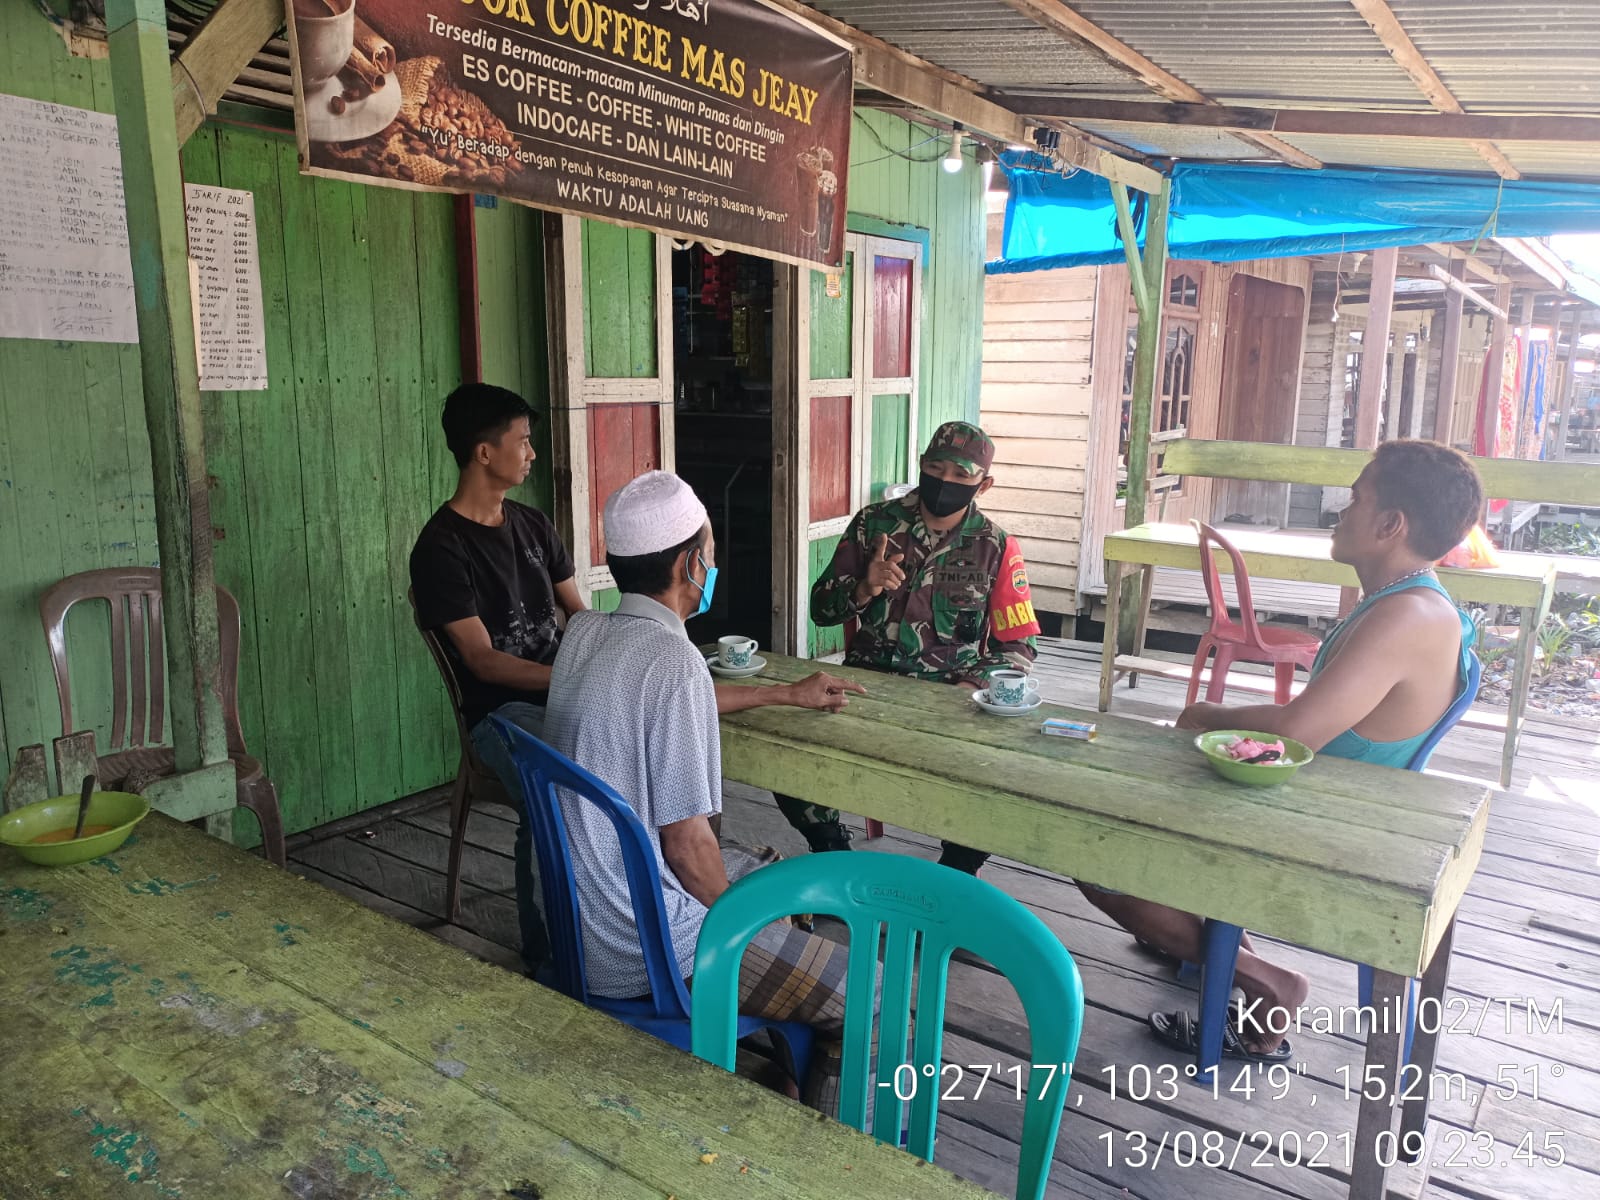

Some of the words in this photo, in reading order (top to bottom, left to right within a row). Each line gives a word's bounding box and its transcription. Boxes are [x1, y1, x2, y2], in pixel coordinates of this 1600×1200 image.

[426, 13, 497, 52] Tersedia
[501, 37, 635, 94] Bermacam-macam
[638, 81, 695, 114] Minuman
[698, 101, 730, 126] Panas
[733, 113, 751, 133] dan
[755, 120, 785, 145] Dingin
[546, 0, 671, 72] COFFEE
[681, 36, 746, 98] MAS
[752, 68, 819, 125] JEAY
[462, 53, 490, 82] ES
[495, 64, 572, 105] COFFEE
[587, 91, 652, 128] COFFEE
[665, 114, 711, 146] WHITE
[715, 130, 767, 163] COFFEE
[518, 102, 612, 146] INDOCAFE
[627, 132, 659, 159] DAN
[664, 142, 733, 179] LAIN-LAIN
[227, 195, 244, 205] 2021
[457, 136, 510, 159] Beradap
[515, 148, 556, 170] dengan
[561, 157, 594, 178] Penuh
[597, 165, 653, 192] Kesopanan
[657, 181, 678, 199] Agar
[681, 186, 719, 208] Tercipta
[721, 197, 755, 216] Suasana
[557, 178, 612, 207] WAKTU
[619, 195, 671, 220] ADALAH
[677, 207, 709, 228] UANG
[938, 571, 985, 583] TNI-AD
